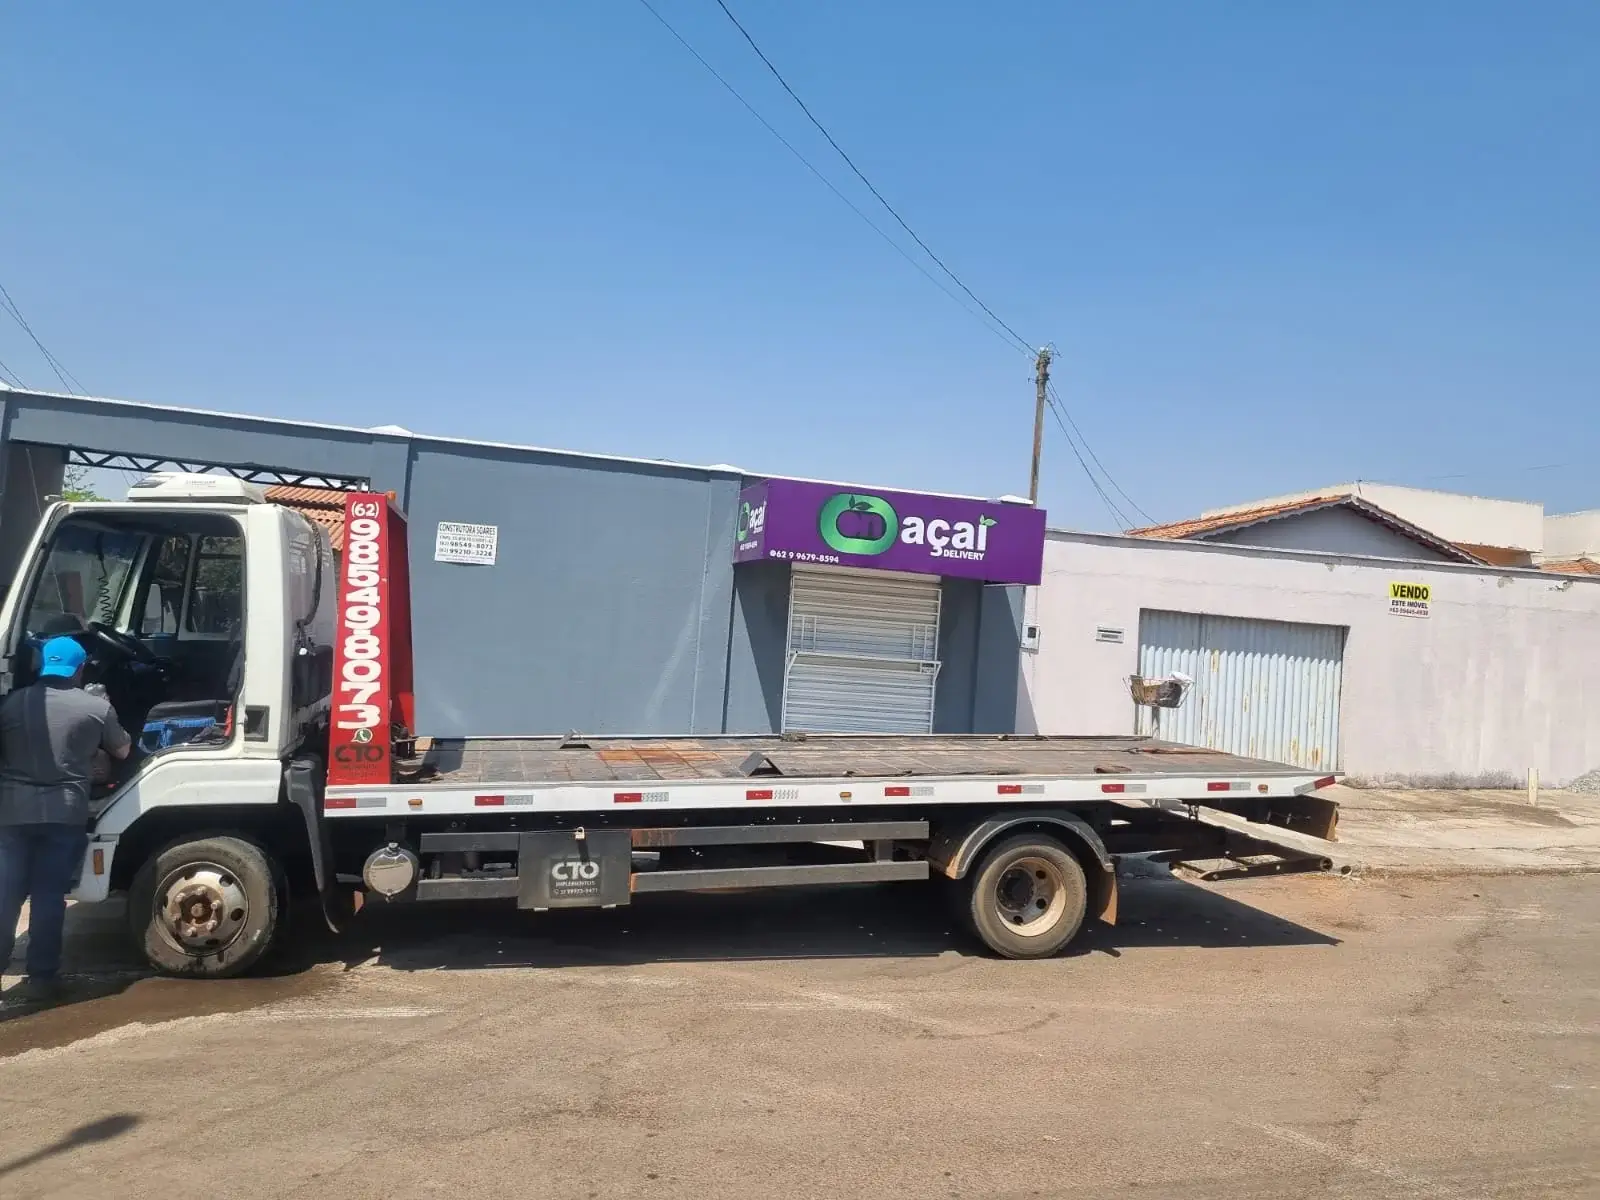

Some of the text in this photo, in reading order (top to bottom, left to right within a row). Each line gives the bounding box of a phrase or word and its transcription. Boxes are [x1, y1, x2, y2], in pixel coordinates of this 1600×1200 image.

[351, 501, 379, 518] (62)
[439, 523, 476, 533] CONSTRUTORA
[476, 527, 496, 536] SOARES
[795, 552, 839, 564] 9679-8594
[943, 549, 985, 561] DELIVERY
[1392, 584, 1429, 599] VENDO
[334, 744, 383, 763] CTO
[551, 861, 600, 880] CTO
